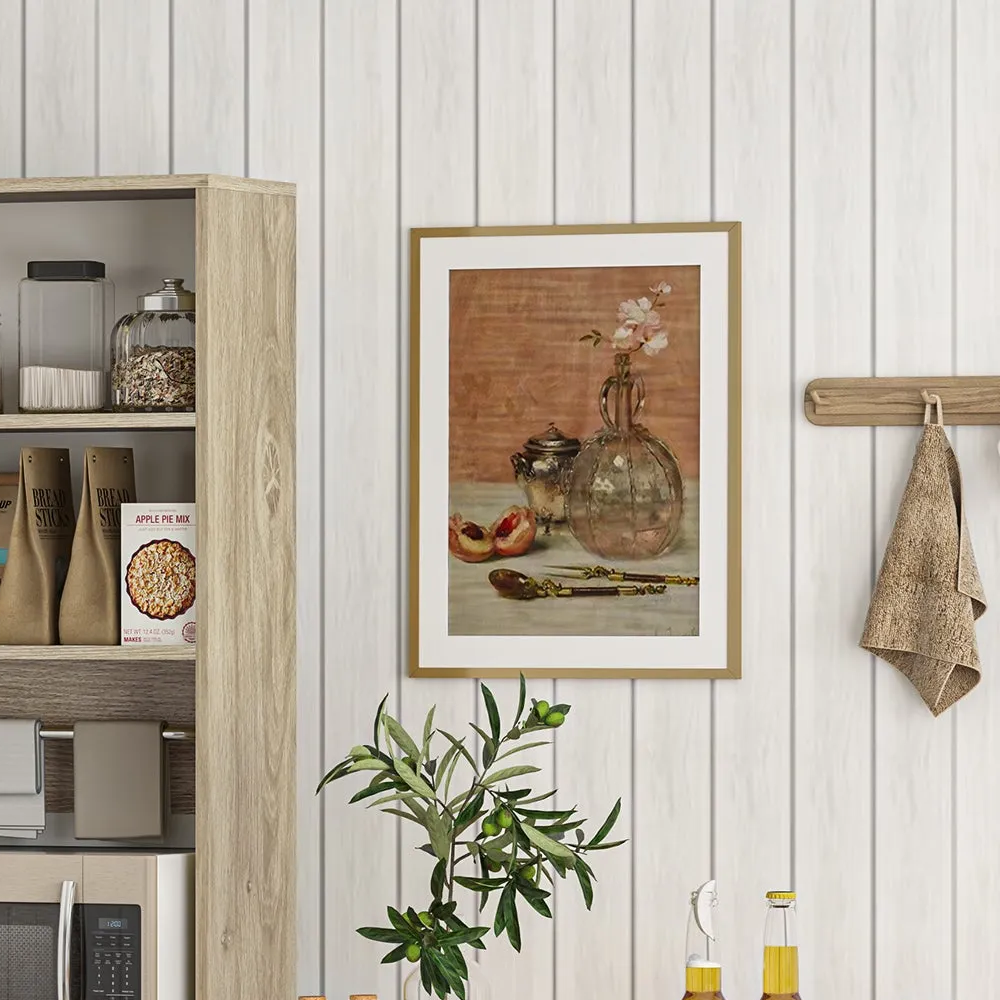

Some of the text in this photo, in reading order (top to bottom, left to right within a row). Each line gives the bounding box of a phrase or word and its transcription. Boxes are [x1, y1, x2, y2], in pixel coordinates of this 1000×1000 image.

[32, 488, 67, 507] BREAD
[135, 514, 191, 524] APPLE PIE MIX
